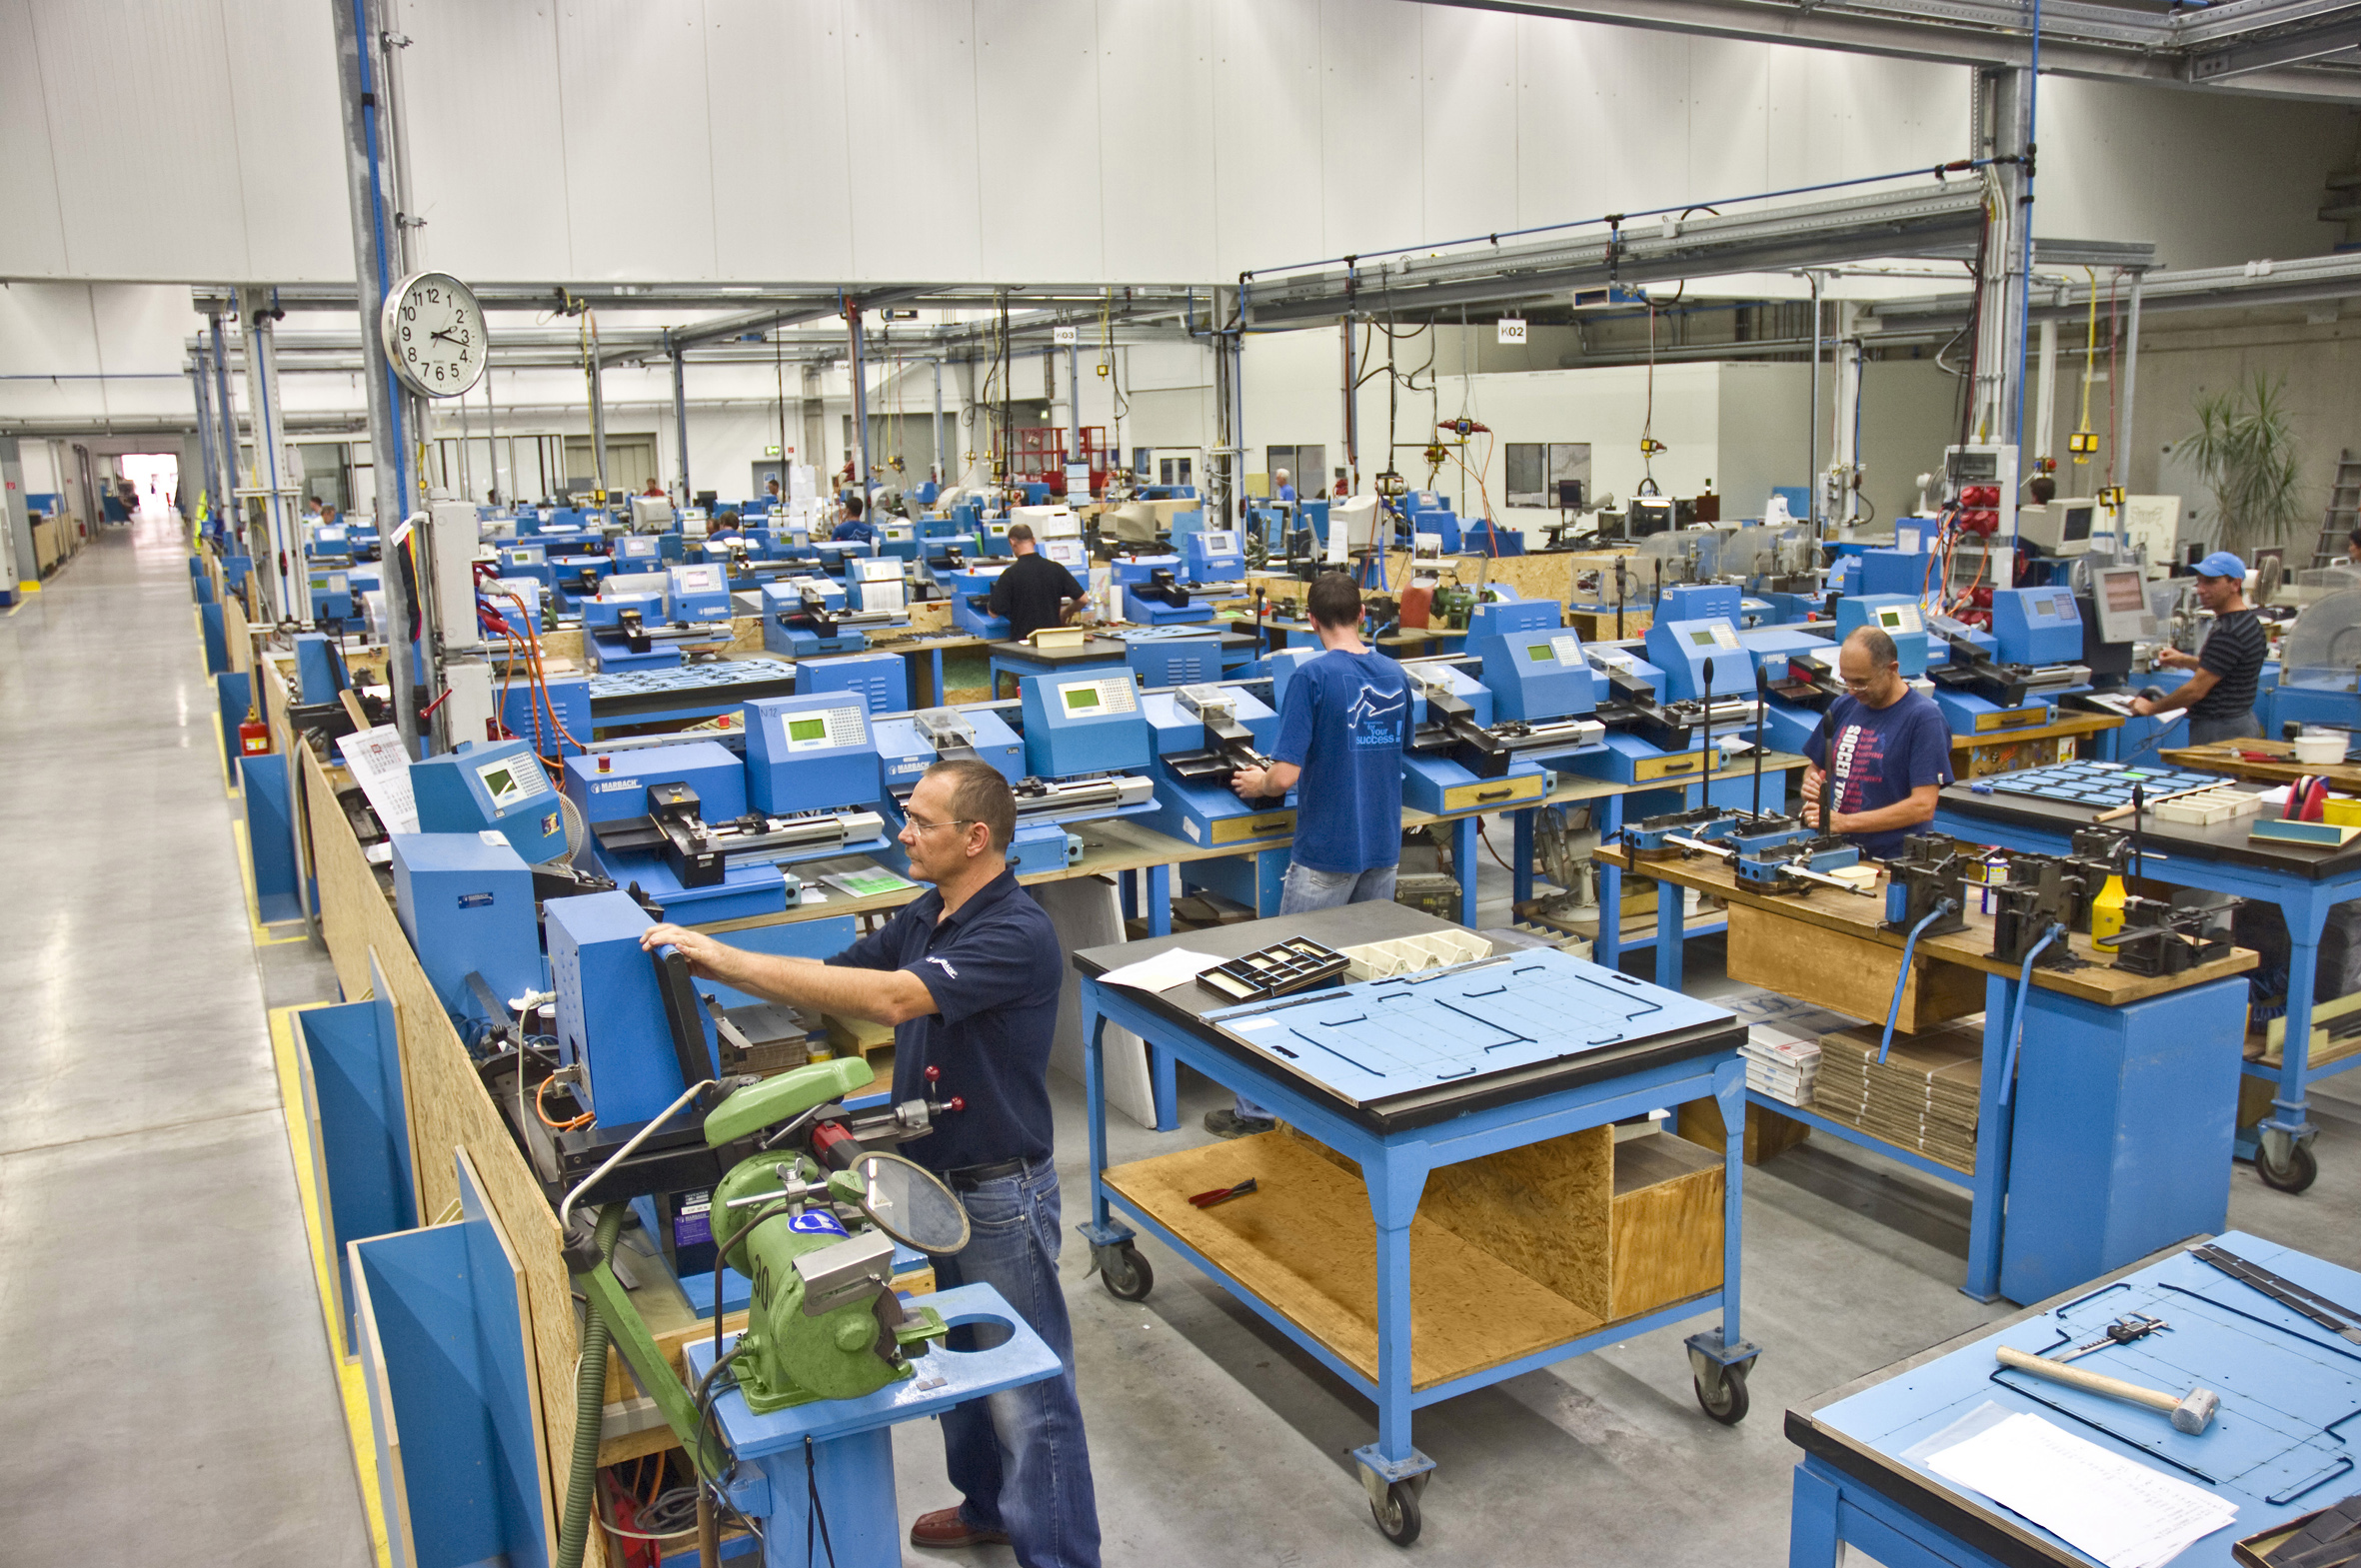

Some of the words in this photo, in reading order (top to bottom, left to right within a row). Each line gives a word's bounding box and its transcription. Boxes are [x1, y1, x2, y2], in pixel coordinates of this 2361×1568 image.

[412, 292, 423, 307] 11
[427, 288, 440, 304] 12
[403, 306, 416, 322] 10
[456, 309, 464, 324] 2
[402, 326, 412, 342] 9
[461, 329, 470, 344] 3
[1056, 331, 1075, 340] K03
[1501, 326, 1523, 337] K02
[408, 347, 418, 362] 8
[459, 349, 468, 363] 4
[421, 362, 430, 377] 7
[435, 366, 445, 381] 6
[450, 363, 460, 378] 5
[1356, 735, 1394, 745] success
[1370, 729, 1388, 738] your
[1836, 725, 1861, 779] SOCCER
[898, 762, 931, 772] MARBACH
[602, 780, 638, 789] MARBACH
[754, 1254, 770, 1312] 30
